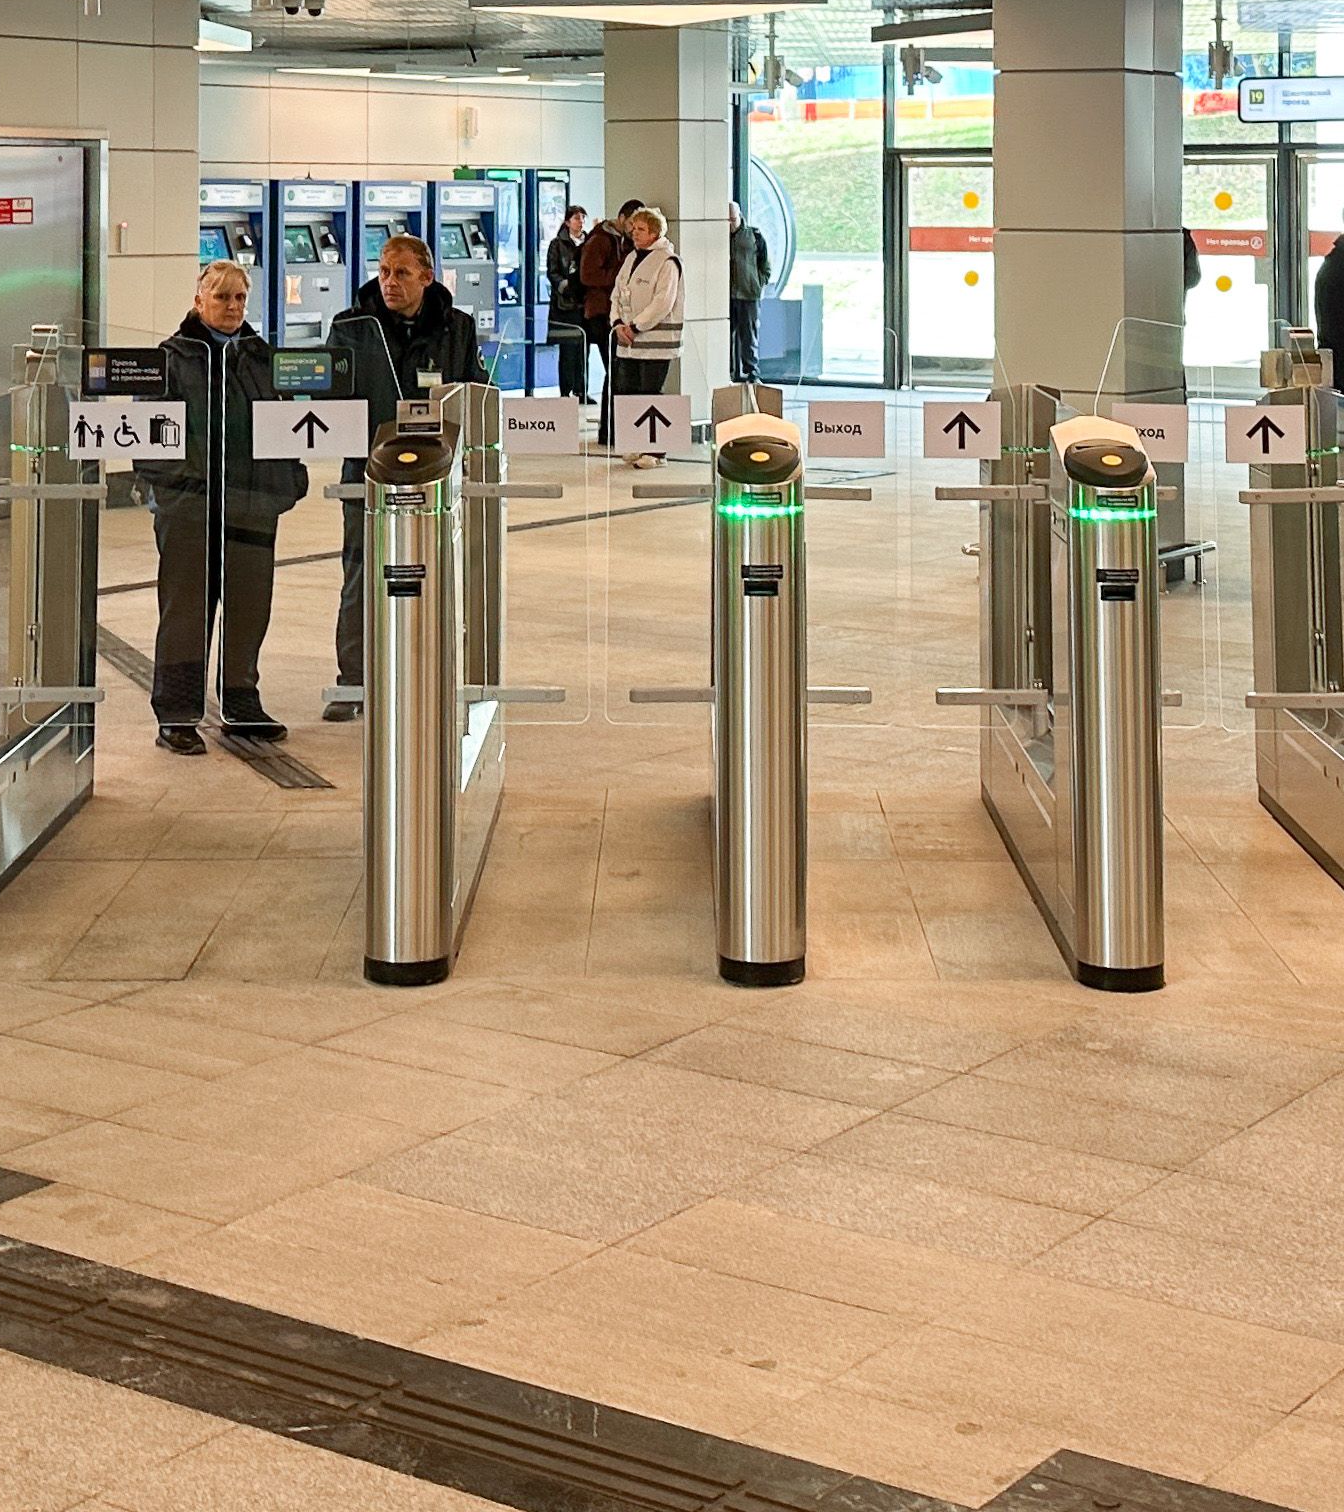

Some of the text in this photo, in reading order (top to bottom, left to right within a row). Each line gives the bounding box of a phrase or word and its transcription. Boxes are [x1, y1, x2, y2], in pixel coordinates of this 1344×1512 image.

[508, 418, 555, 433] Выход
[814, 421, 862, 436] Выход
[1136, 428, 1166, 440] ход
